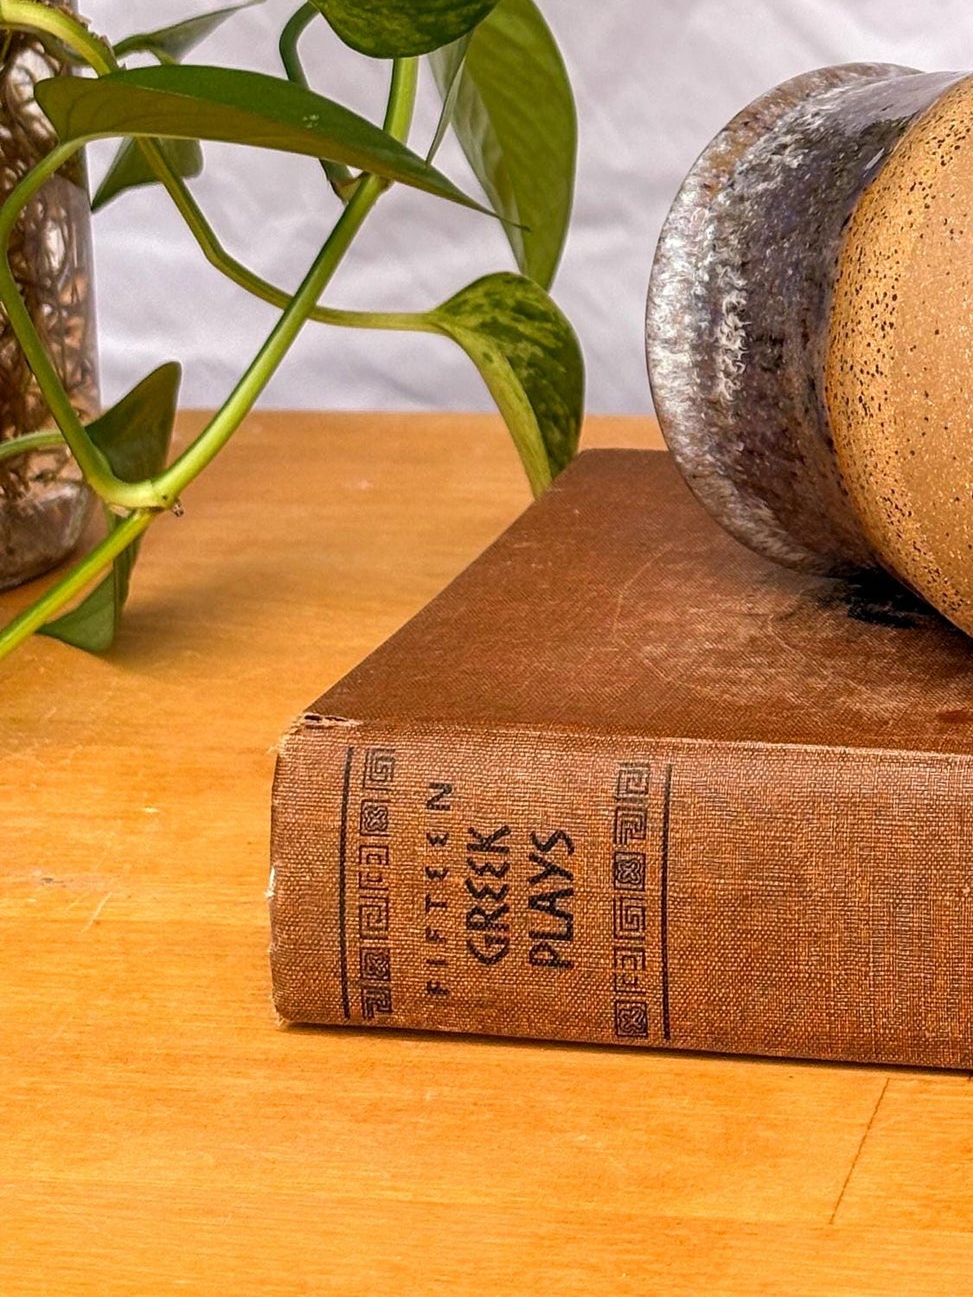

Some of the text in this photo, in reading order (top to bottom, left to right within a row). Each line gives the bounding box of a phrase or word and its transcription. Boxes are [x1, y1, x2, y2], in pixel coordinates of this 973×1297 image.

[425, 782, 453, 997] FIFTEEN
[465, 825, 511, 965] GREEK
[528, 829, 575, 970] PLAYS
